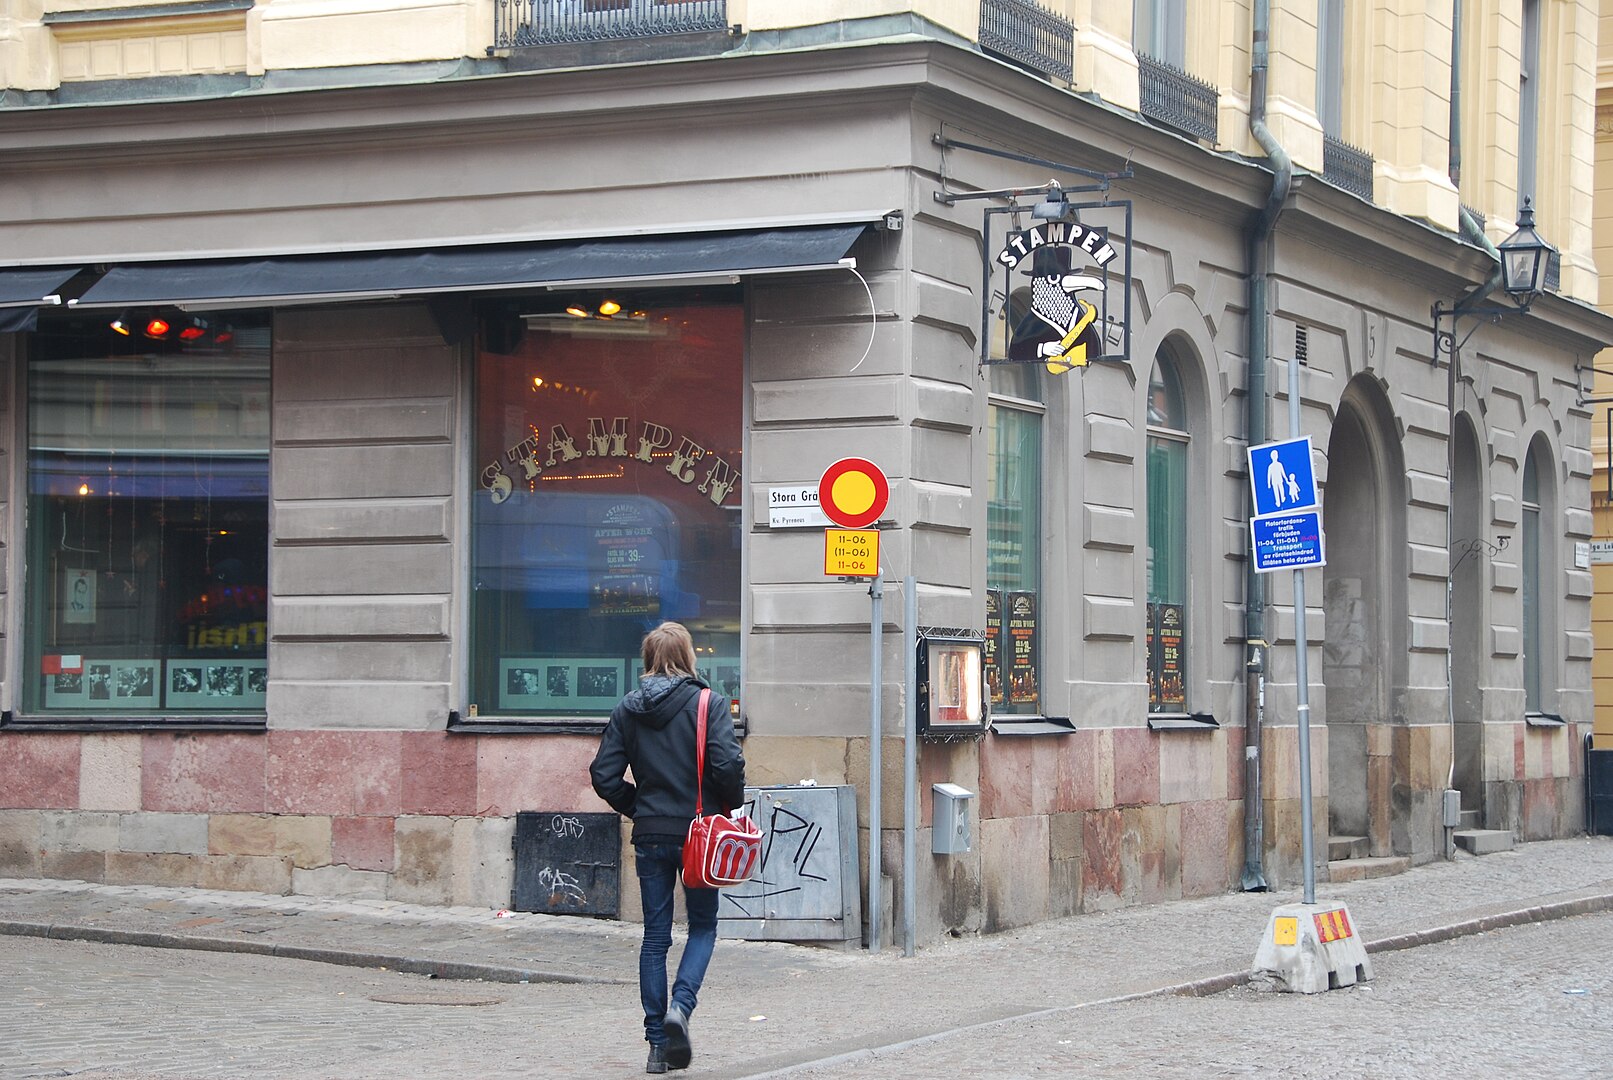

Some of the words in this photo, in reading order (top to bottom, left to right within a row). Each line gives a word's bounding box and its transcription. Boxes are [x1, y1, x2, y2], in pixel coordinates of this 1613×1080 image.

[1000, 223, 1115, 269] STAMPEN
[1369, 326, 1376, 359] 5
[480, 417, 742, 506] STAMPEN
[772, 491, 796, 503] Stora
[801, 490, 818, 502] Grå
[782, 517, 805, 525] Pyreneus
[595, 528, 622, 537] AFTER
[625, 527, 652, 536] WORK
[838, 535, 866, 544] 11-06
[834, 547, 870, 558] (11-06)
[1273, 543, 1302, 551] Transport
[628, 549, 645, 562] 39:-
[838, 561, 866, 570] 11-06
